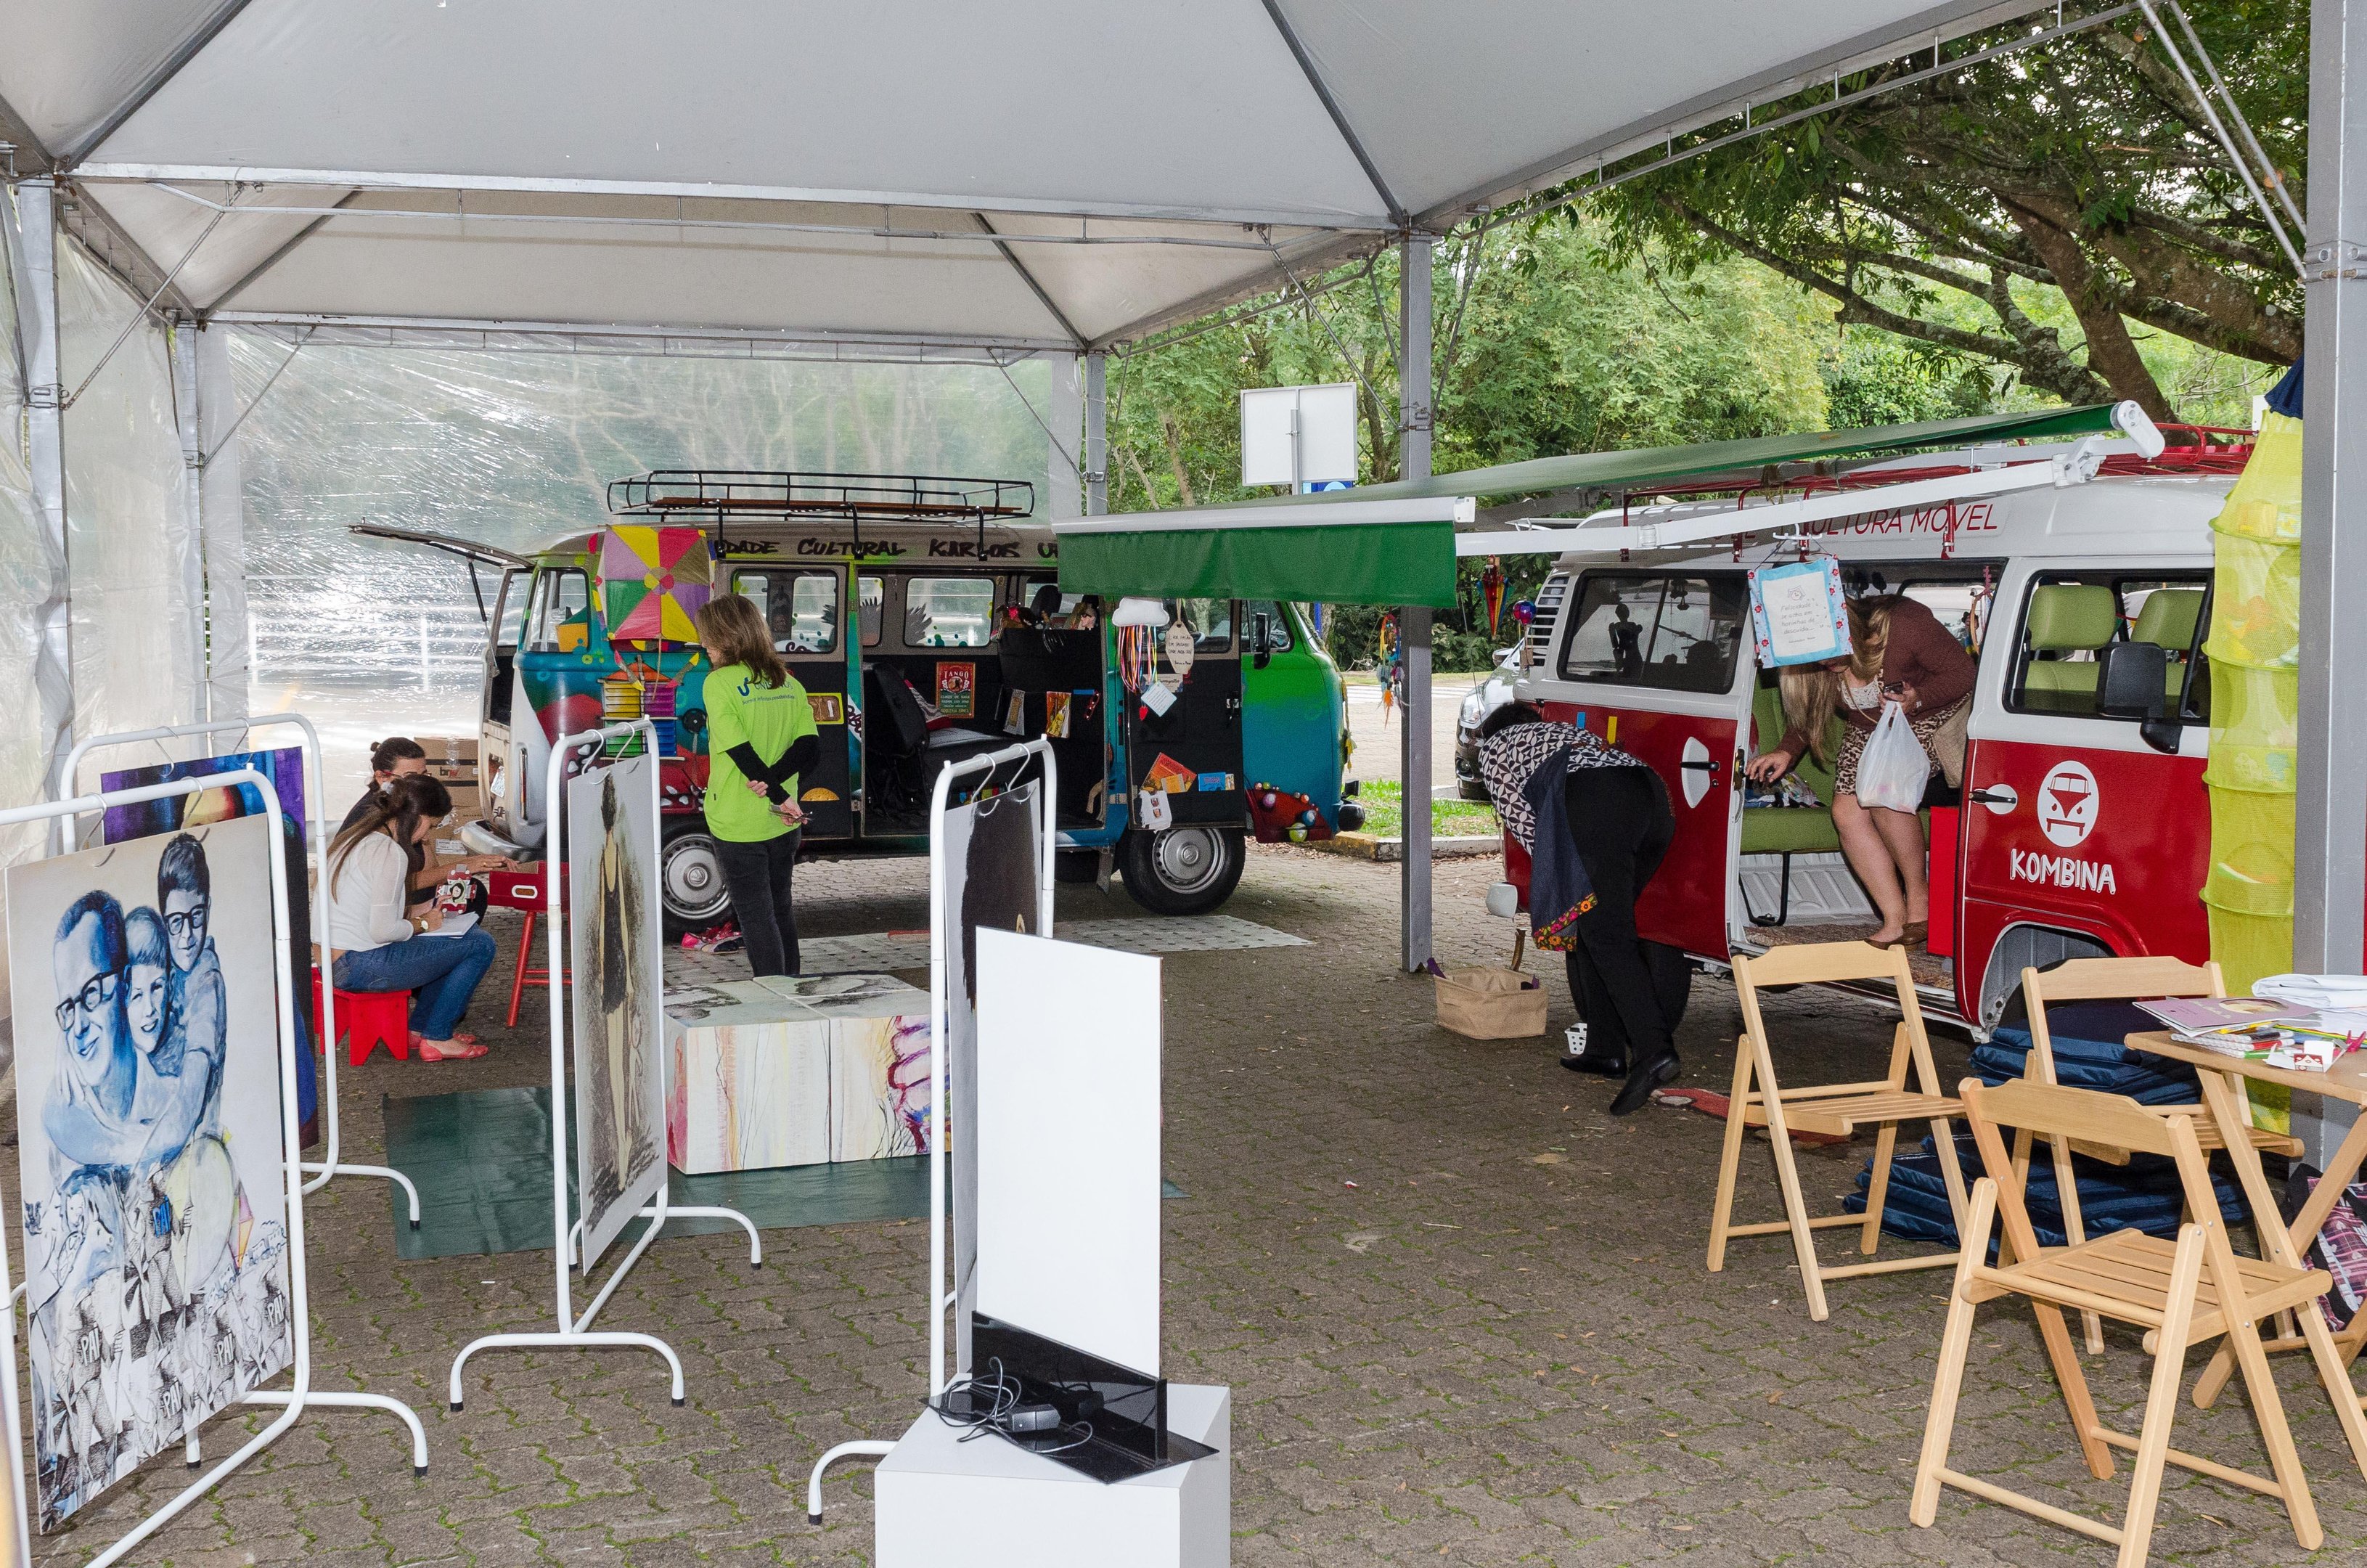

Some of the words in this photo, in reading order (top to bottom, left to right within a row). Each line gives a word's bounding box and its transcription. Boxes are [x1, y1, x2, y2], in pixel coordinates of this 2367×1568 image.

[1910, 501, 1998, 532] MÓVEL
[944, 671, 969, 679] TANGO
[2010, 848, 2117, 895] KOMBINA
[152, 1195, 171, 1238] PAI
[266, 1288, 285, 1328] PAI
[81, 1320, 100, 1366] PAI
[217, 1328, 234, 1369] PAI
[163, 1376, 182, 1419] PAI
